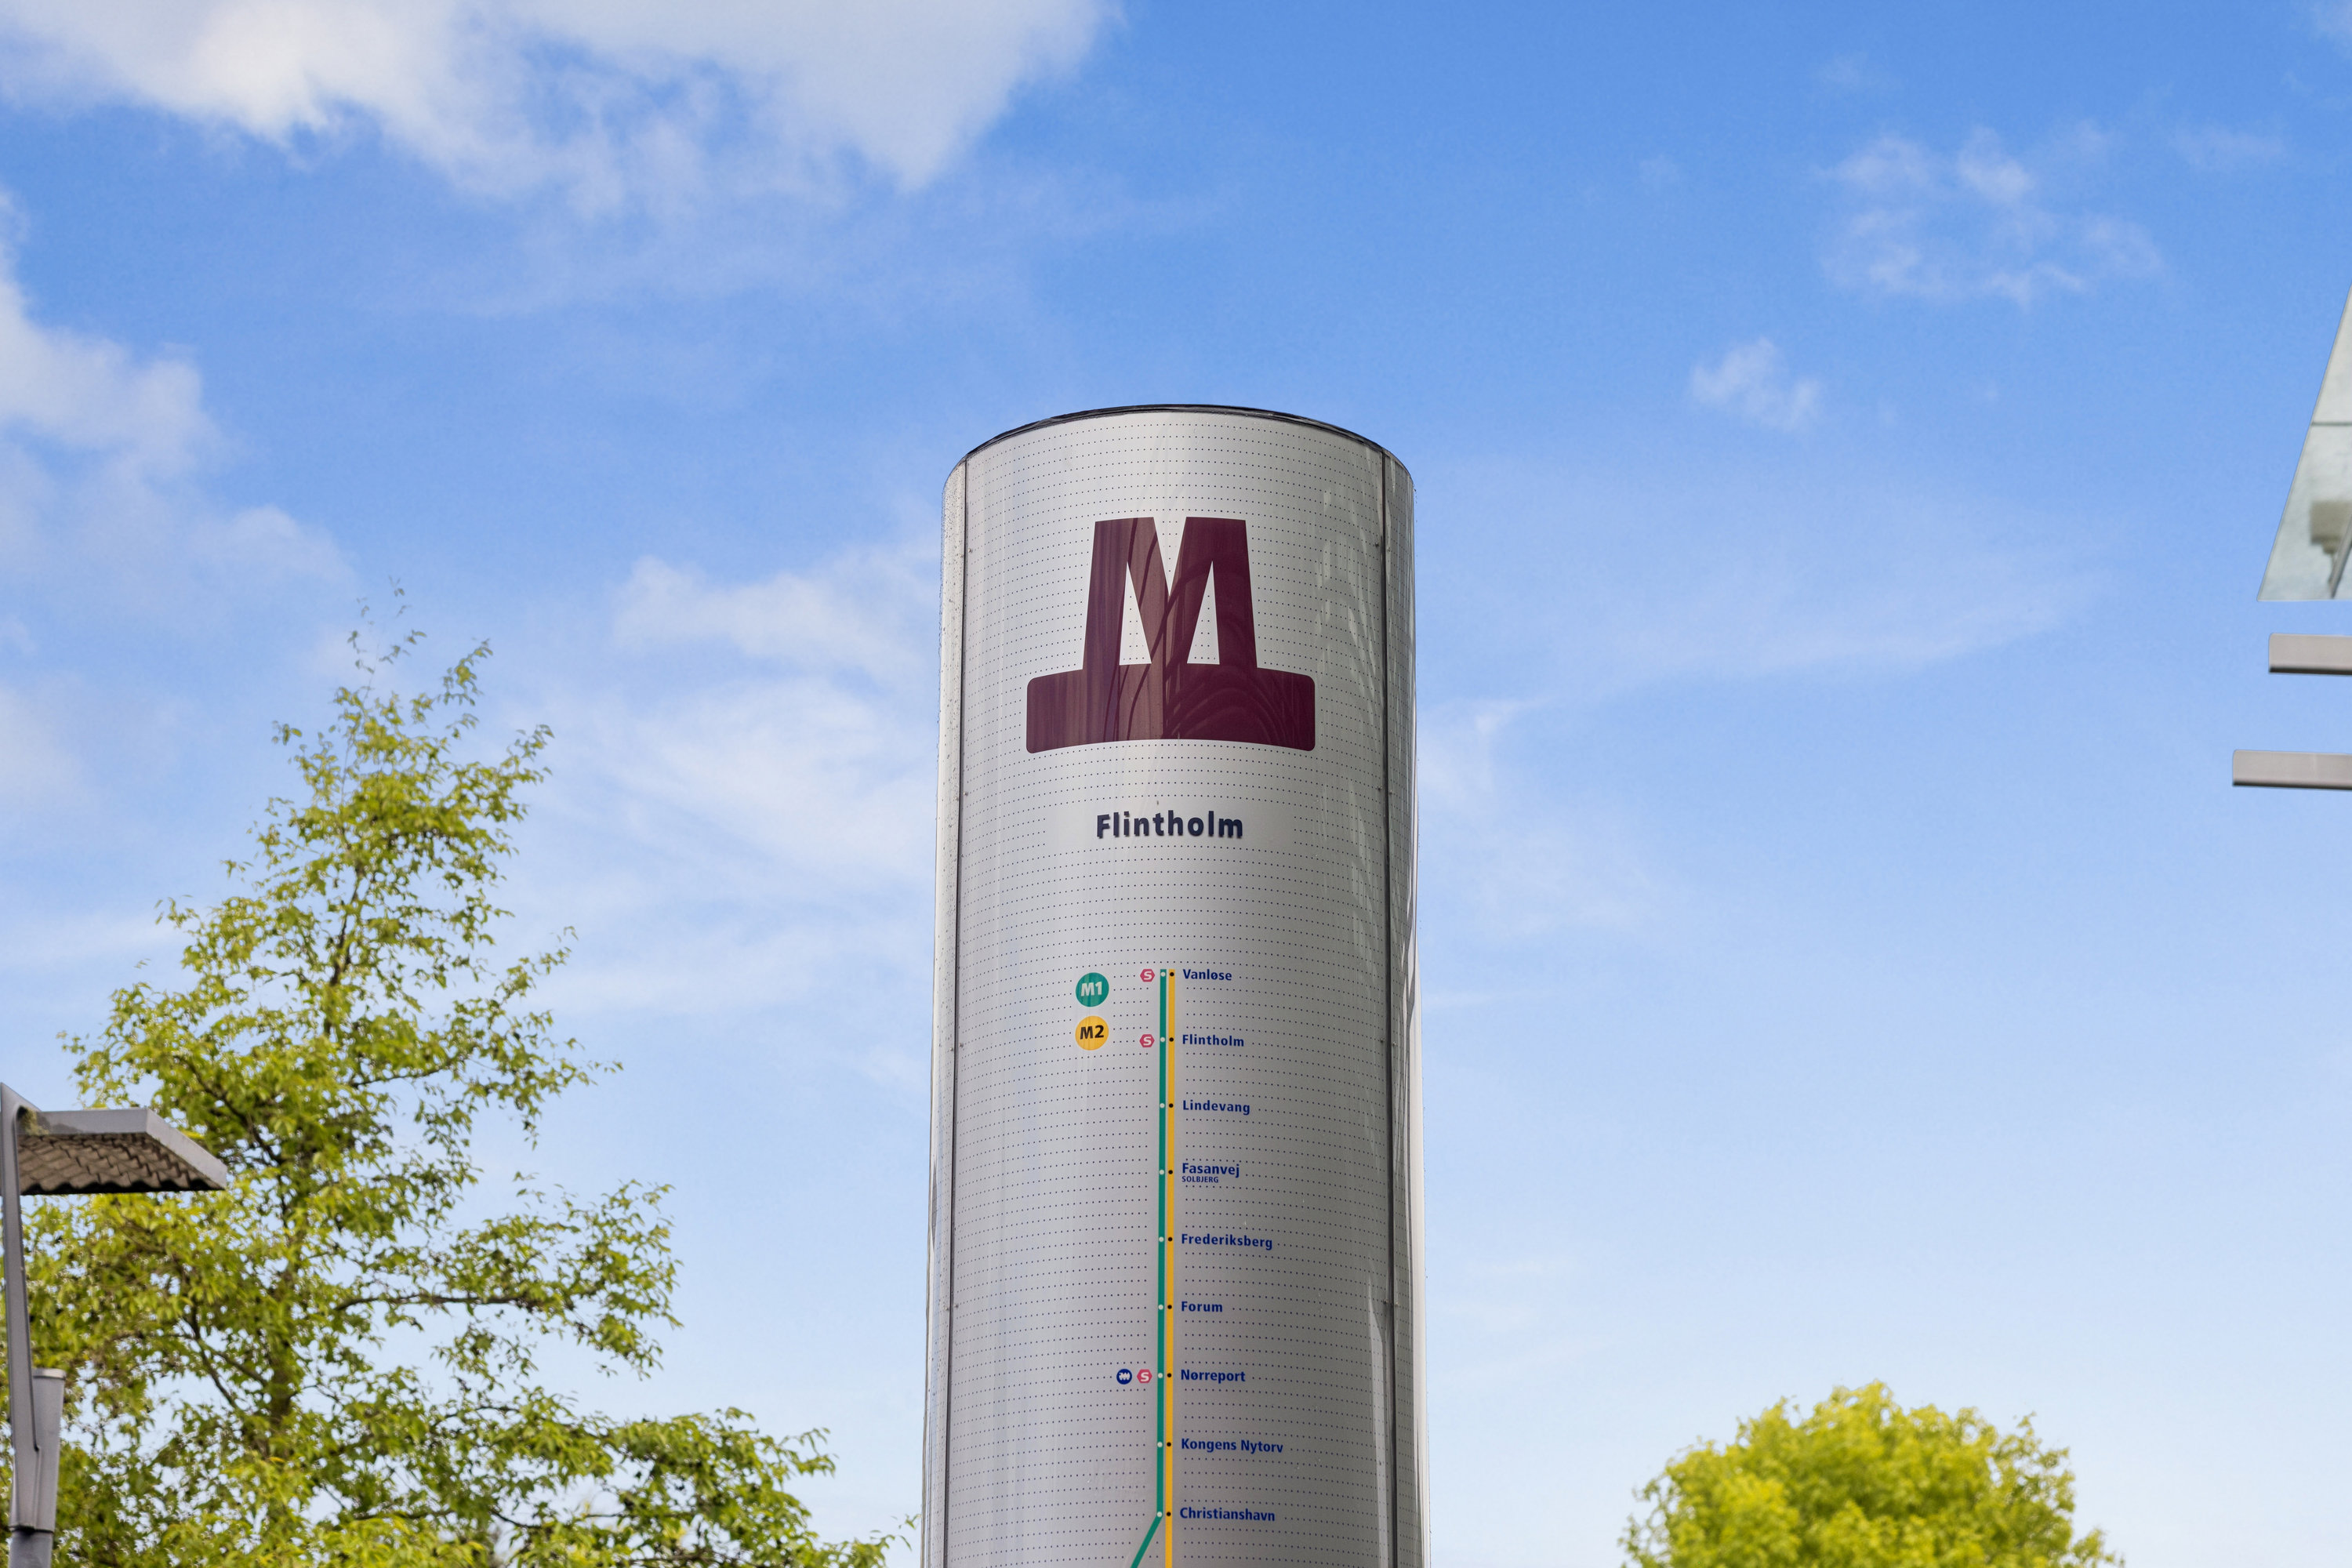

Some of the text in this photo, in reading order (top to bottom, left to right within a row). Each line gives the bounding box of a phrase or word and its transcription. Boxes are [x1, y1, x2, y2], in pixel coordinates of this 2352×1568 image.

[1097, 810, 1243, 838] Flintholm
[1182, 969, 1232, 981] Vanløse
[1080, 982, 1102, 996] M1
[1080, 1025, 1105, 1040] M2
[1182, 1034, 1244, 1047] Flintholm
[1182, 1100, 1250, 1115] Lindevang
[1181, 1163, 1240, 1178] Fasanvej
[1181, 1233, 1273, 1250] Frederiksberg
[1181, 1301, 1223, 1312] Forum
[1181, 1370, 1246, 1384] Nørreport
[1181, 1439, 1283, 1454] Kongens Nytorv
[1180, 1507, 1276, 1522] Christianshavn
